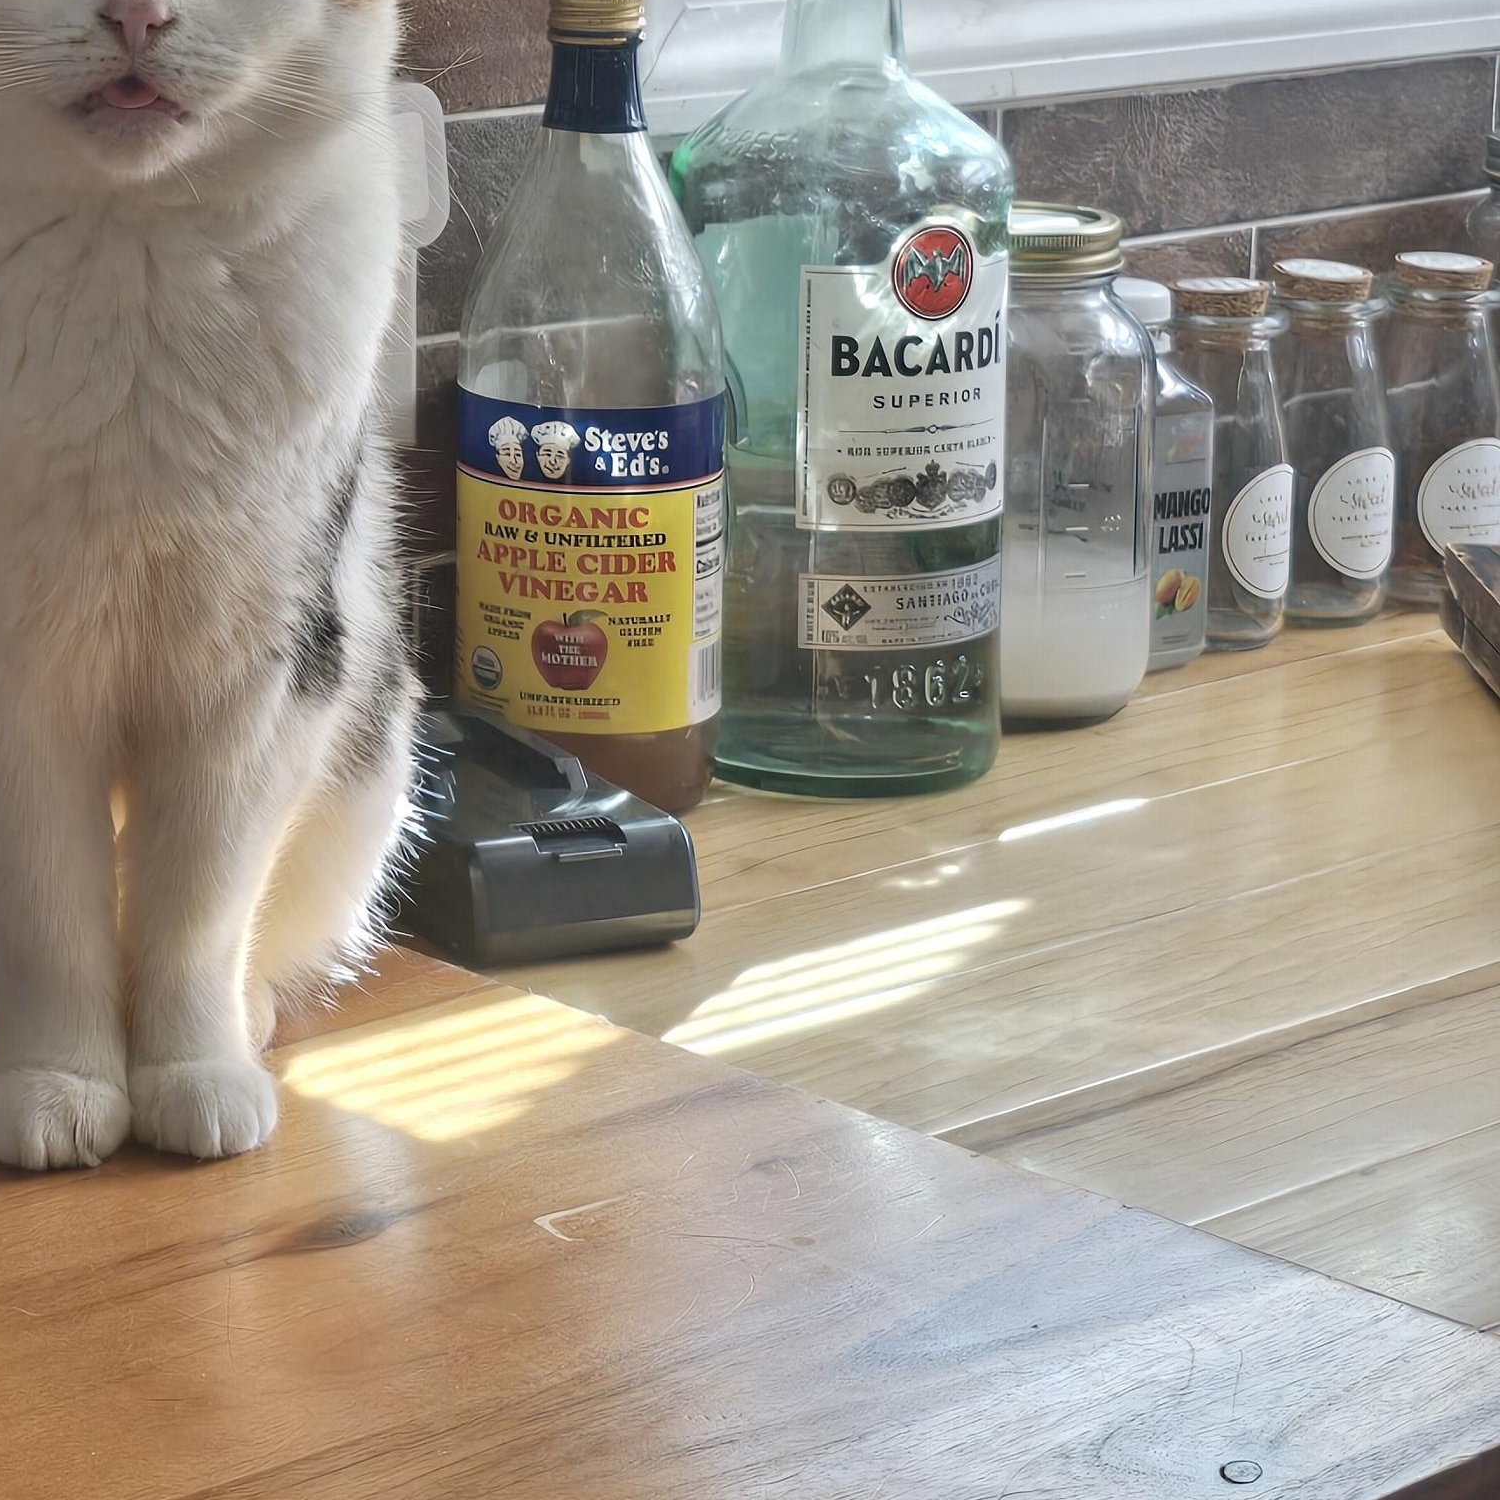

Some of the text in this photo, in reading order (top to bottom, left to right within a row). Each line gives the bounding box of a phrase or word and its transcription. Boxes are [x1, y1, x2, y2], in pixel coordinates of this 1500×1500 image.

[872, 387, 982, 410] SUPERIOR
[584, 426, 669, 453] Steve's
[594, 455, 607, 472] &
[498, 498, 650, 530] ORGANIC
[1153, 487, 1211, 520] MANGO
[484, 520, 667, 549] RAW & UNFILTERED
[1158, 523, 1204, 554] LASSI
[476, 538, 567, 574] APPLE
[576, 550, 677, 576] CIDER
[498, 570, 650, 605] VINEGAR
[895, 589, 969, 610] SANTIAGO
[541, 651, 598, 668] MOTHER
[558, 644, 581, 655] THE
[864, 653, 971, 713] 1862
